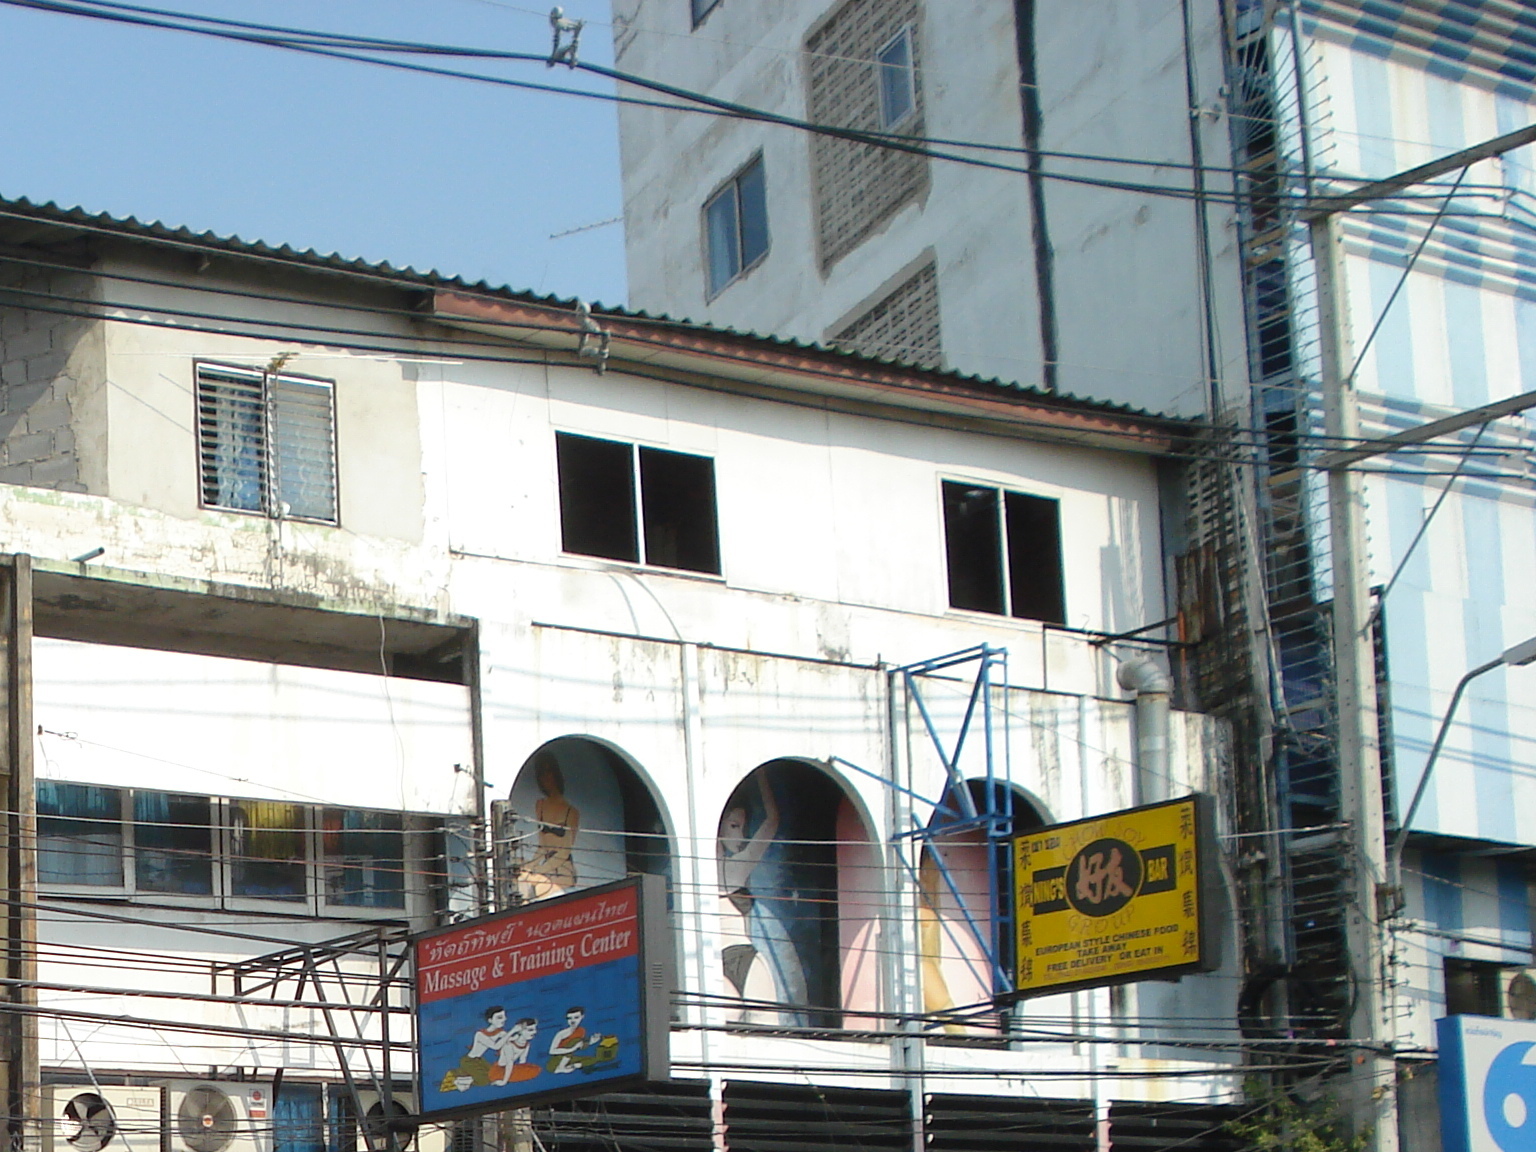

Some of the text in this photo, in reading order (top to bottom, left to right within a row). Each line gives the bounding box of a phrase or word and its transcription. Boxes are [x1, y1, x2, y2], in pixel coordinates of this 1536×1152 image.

[1147, 857, 1169, 882] BAR
[1068, 905, 1135, 935] GROUP
[1035, 924, 1179, 956] EUROPEAN STYLE CHINESE FOOD
[1077, 942, 1127, 957] TAKE AWAY
[424, 929, 632, 994] Massage & Training Center
[1047, 945, 1164, 972] FREE DELIVERY OR EAT IN
